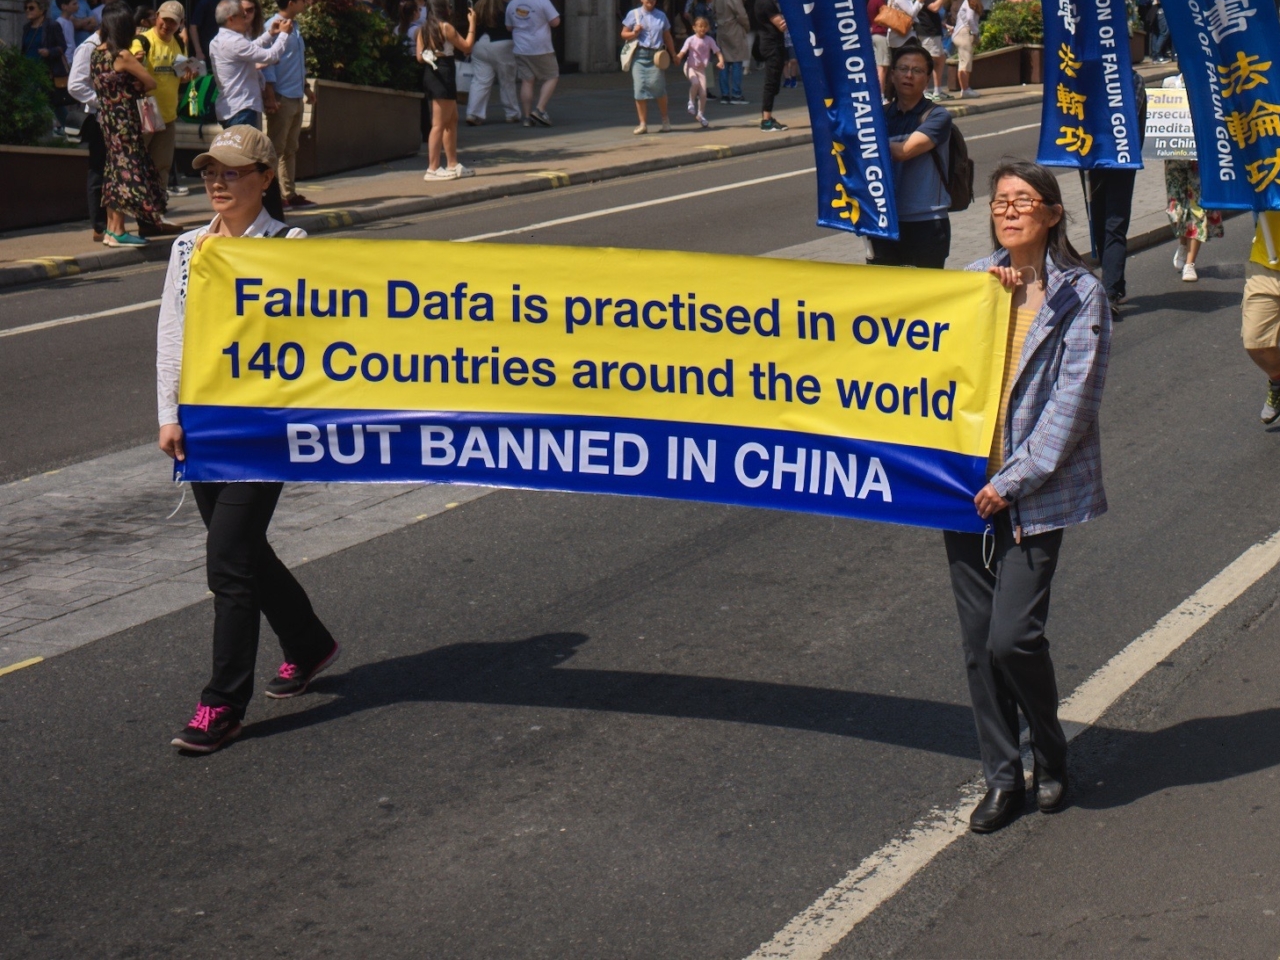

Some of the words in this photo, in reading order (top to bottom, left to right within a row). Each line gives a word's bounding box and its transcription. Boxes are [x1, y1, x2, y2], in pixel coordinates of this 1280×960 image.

[1098, 25, 1116, 48] OF
[1197, 31, 1214, 59] OF
[844, 54, 868, 84] OF
[1101, 53, 1123, 108] FALUN
[1205, 62, 1225, 122] FALUN
[850, 90, 880, 160] FALUN
[1147, 93, 1183, 105] Falun
[1110, 112, 1131, 165] GONG
[1146, 122, 1194, 134] medita
[1155, 138, 1167, 149] in
[1169, 138, 1196, 149] Chin
[1156, 149, 1197, 157] Faluninfo.ne
[1214, 125, 1236, 182] GONG
[234, 277, 368, 319] Falun
[387, 279, 495, 322] Dafa
[512, 284, 549, 324] is
[564, 292, 781, 337] practised
[797, 300, 836, 342] in
[851, 314, 950, 354] over
[222, 341, 306, 382] 140
[322, 341, 557, 389] Countries
[572, 358, 734, 398] around
[748, 361, 822, 406] the
[835, 377, 957, 423] world
[286, 422, 402, 466] BUT
[420, 425, 649, 478] BANNED
[667, 436, 718, 484] IN
[733, 440, 893, 504] CHINA
